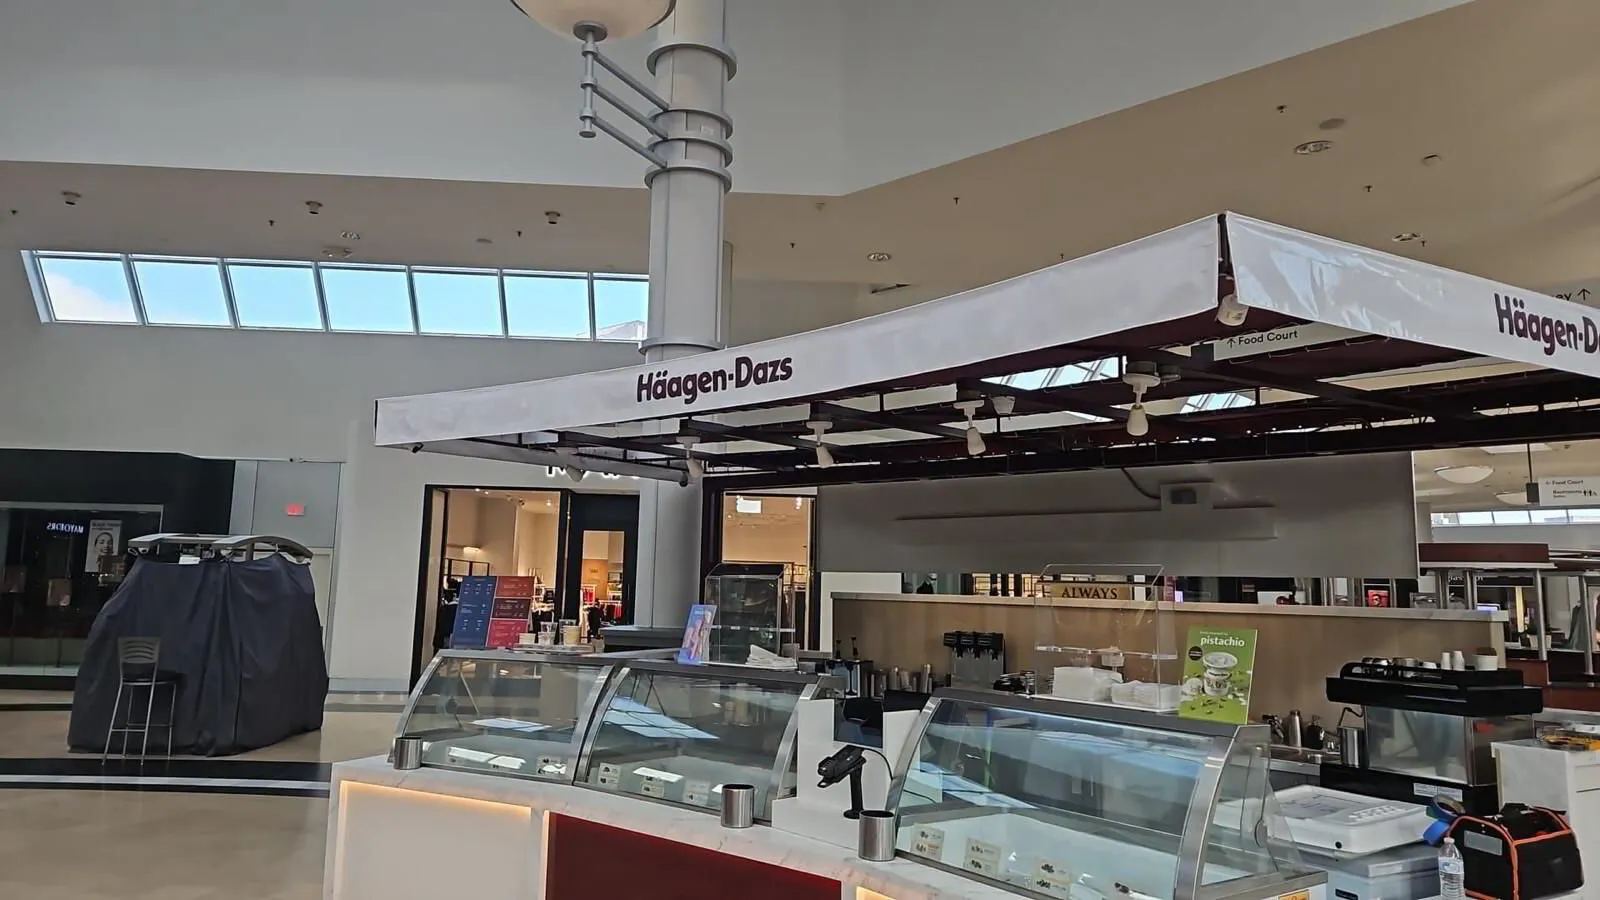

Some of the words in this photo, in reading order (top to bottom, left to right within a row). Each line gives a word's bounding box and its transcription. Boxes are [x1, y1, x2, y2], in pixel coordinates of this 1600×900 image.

[1494, 292, 1600, 356] Häagen-D
[1238, 335, 1264, 345] Food
[1266, 330, 1298, 341] Court
[636, 356, 793, 405] Häagen-Dazs
[1061, 587, 1118, 600] ALWAYS
[1200, 635, 1245, 647] pistachio
